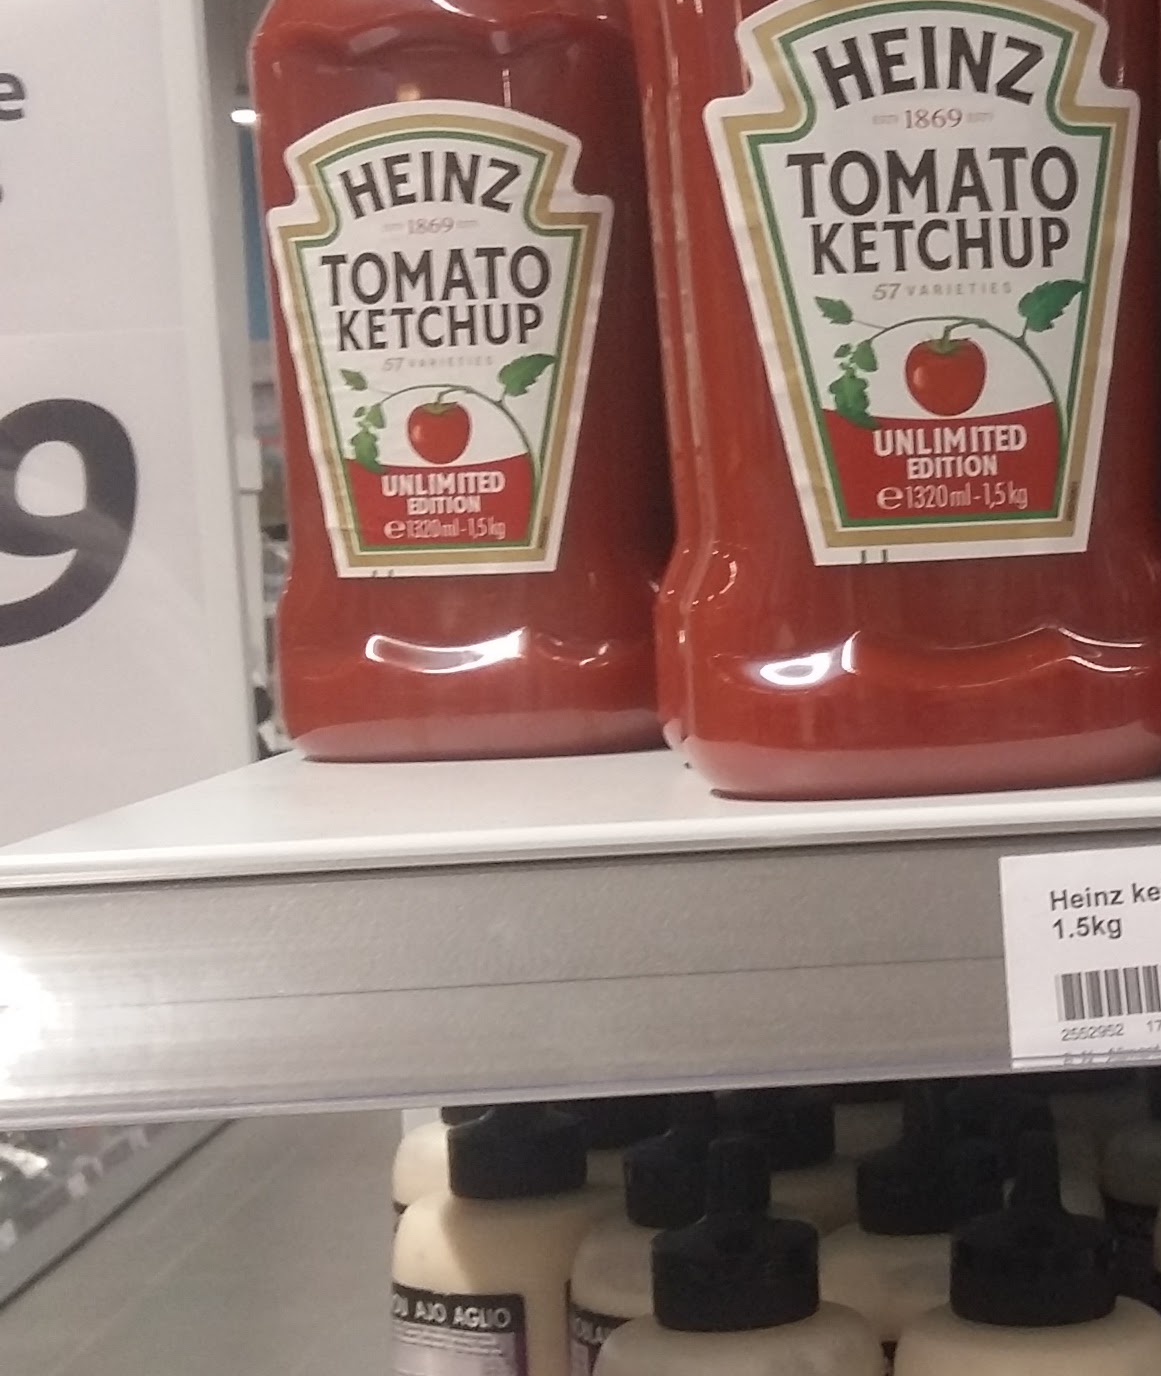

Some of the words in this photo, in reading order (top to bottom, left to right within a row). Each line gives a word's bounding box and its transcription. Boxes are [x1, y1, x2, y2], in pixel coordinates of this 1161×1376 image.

[812, 26, 1045, 109] HEINZ
[904, 108, 963, 129] 1869
[339, 151, 521, 219] HEINZ
[786, 146, 1079, 218] TOMATO
[407, 216, 454, 235] 1869
[811, 217, 1070, 276] KETCHUP
[321, 245, 551, 307] TOMATO
[338, 303, 543, 352] KETCHUP
[873, 424, 1028, 457] UNLIMITED
[906, 454, 998, 480] EDITION
[381, 471, 506, 497] UNLIMITED
[407, 495, 481, 516] EDITION
[1050, 887, 1124, 912] Heinz
[1052, 915, 1123, 940] 1.5kg
[452, 1304, 512, 1328] AGLIO
